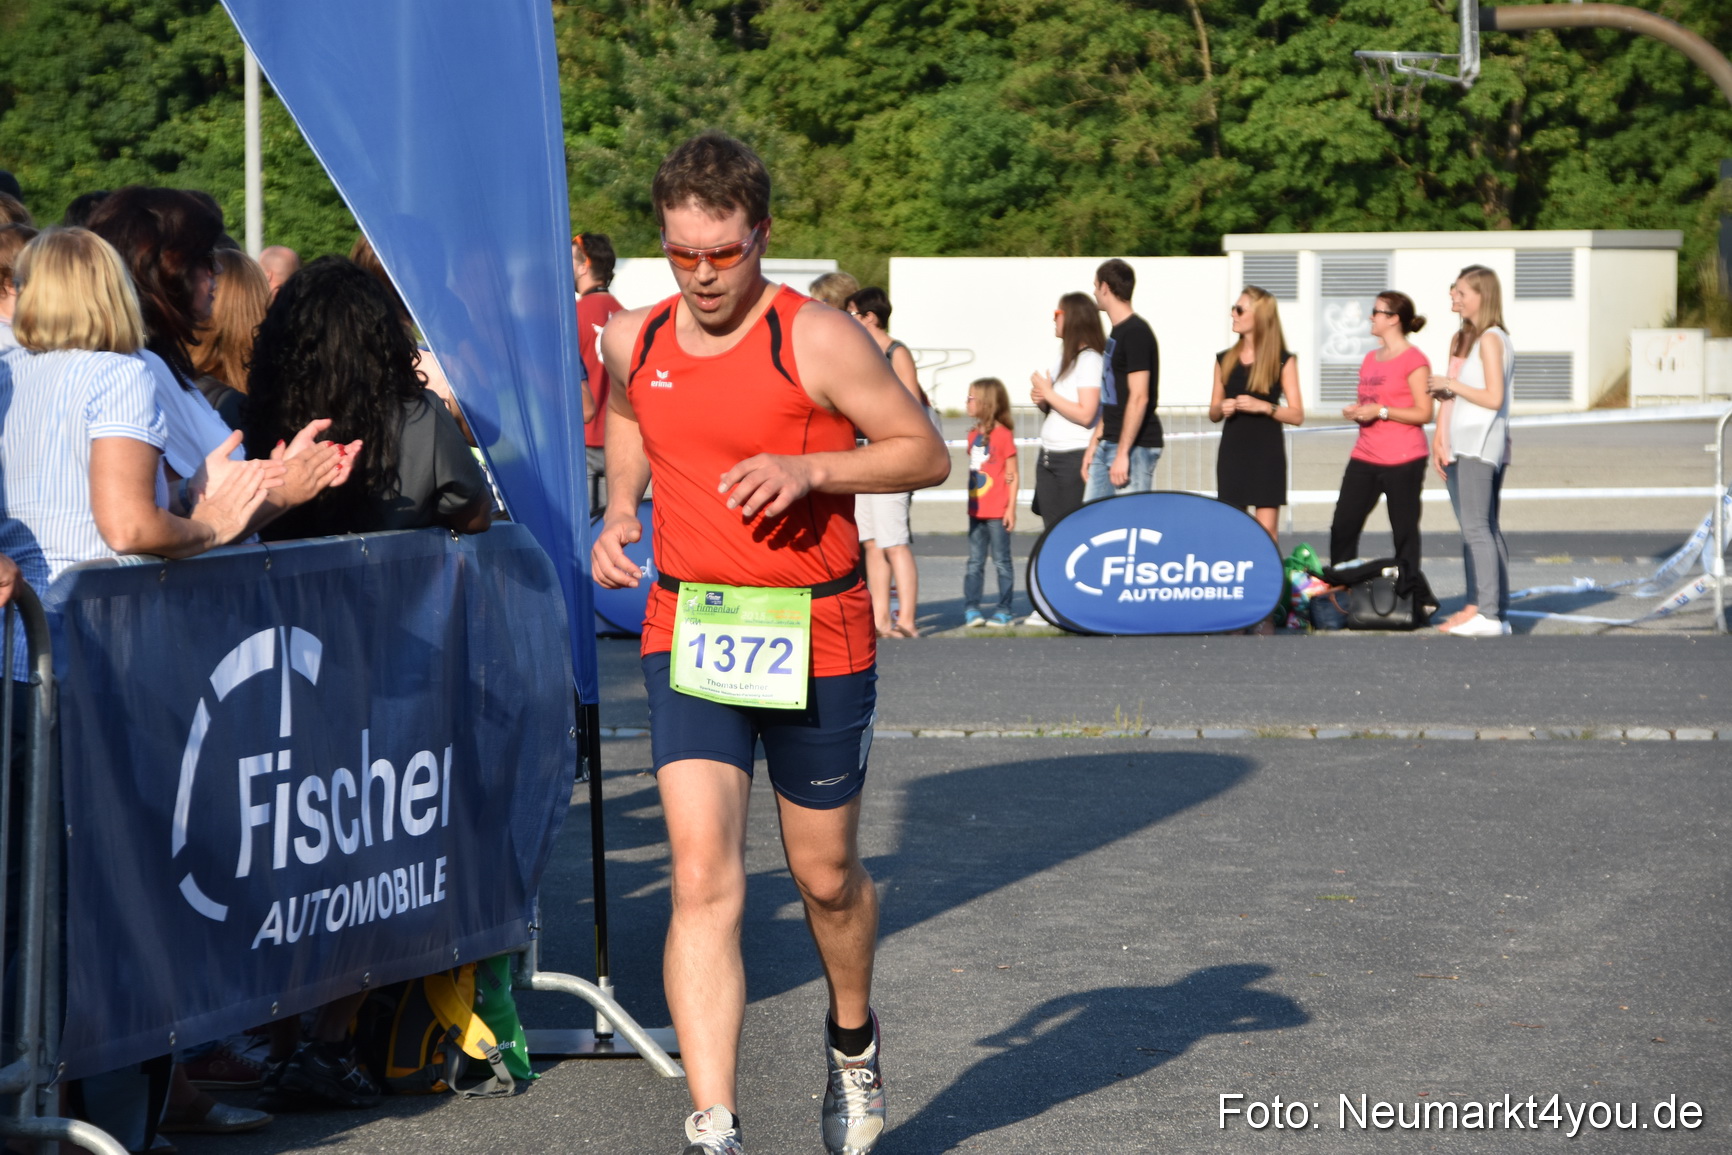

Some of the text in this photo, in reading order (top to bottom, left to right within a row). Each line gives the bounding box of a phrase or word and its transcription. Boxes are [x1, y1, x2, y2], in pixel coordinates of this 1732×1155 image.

[651, 380, 673, 388] erima
[1102, 553, 1254, 586] Fischer
[1118, 587, 1244, 603] AUTOMOBILE
[696, 603, 740, 615] firmenlauf
[688, 633, 794, 675] 1372
[706, 678, 769, 691] Thomas Lehner
[251, 856, 447, 950] AUTOMOBILE
